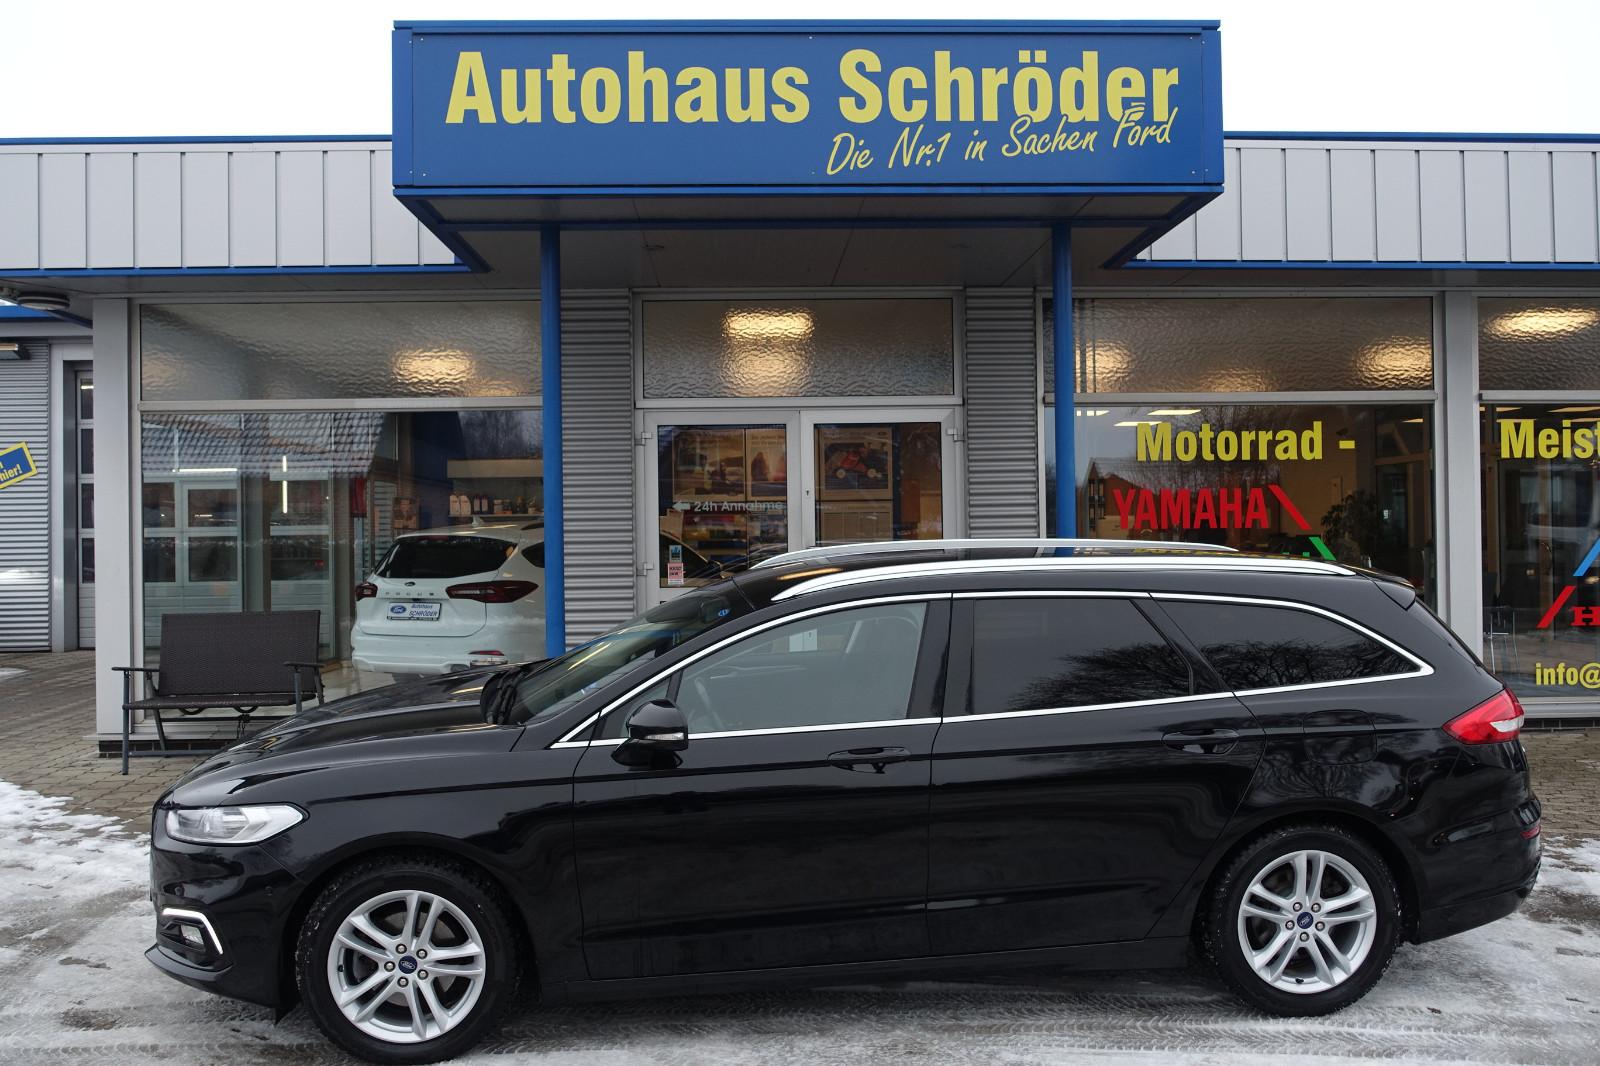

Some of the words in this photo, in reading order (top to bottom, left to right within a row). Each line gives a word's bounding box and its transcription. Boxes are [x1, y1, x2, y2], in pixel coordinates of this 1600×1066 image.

[445, 50, 810, 124] Autohaus
[838, 48, 1179, 124] Schröder
[826, 131, 873, 176] Die
[888, 123, 951, 170] Nr.1
[965, 129, 988, 161] in
[1001, 115, 1098, 158] Sachen
[1112, 101, 1179, 148] Ford
[1136, 421, 1323, 462] Motorrad
[694, 501, 718, 512] 24h
[721, 500, 787, 512] Annahme
[1113, 487, 1270, 529] YAMAHA
